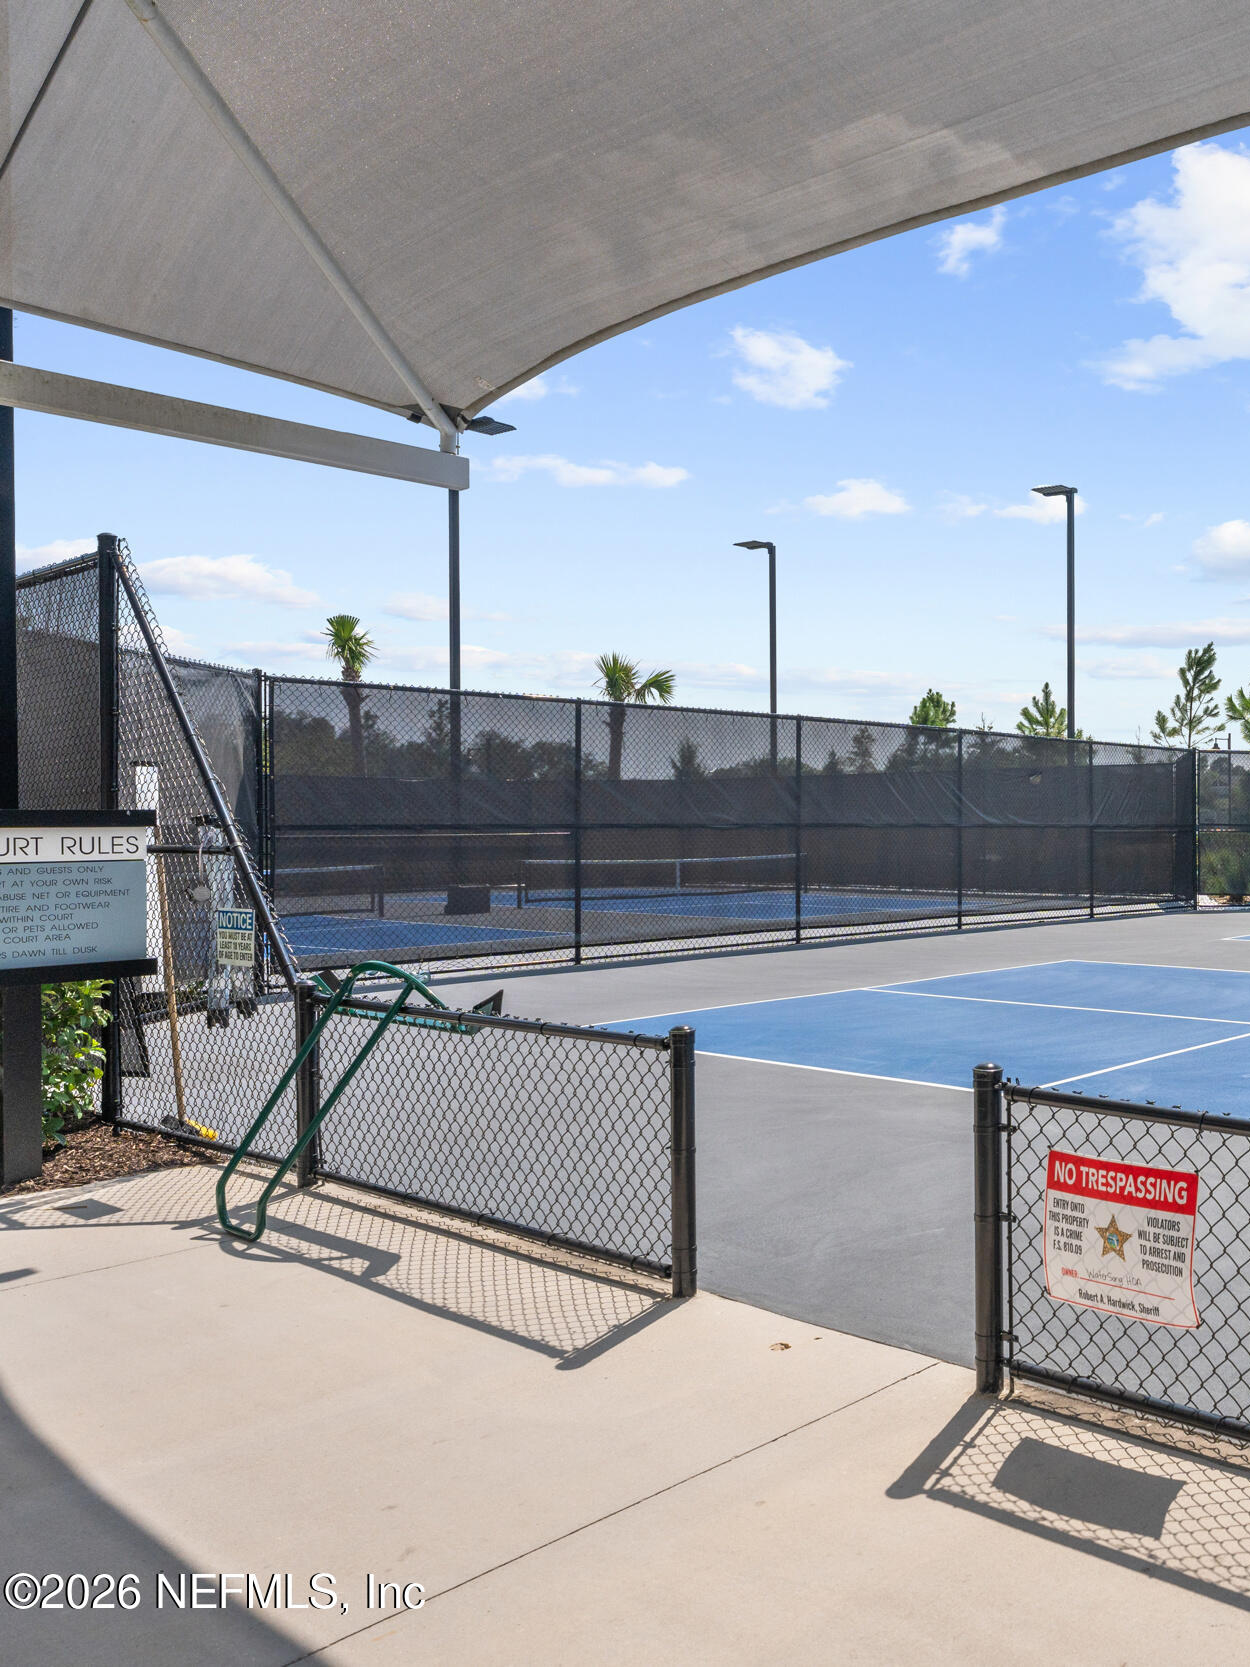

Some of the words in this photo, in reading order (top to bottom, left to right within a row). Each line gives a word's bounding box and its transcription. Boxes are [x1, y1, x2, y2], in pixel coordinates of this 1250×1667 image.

[61, 836, 139, 855] RULES
[7, 867, 31, 876] AND
[37, 866, 73, 875] GUESTS
[77, 865, 105, 873] ONLY
[11, 881, 24, 889] AT
[30, 879, 58, 888] YOUR
[63, 878, 89, 886] OWN
[94, 877, 113, 885] RISK
[32, 892, 50, 900] NET
[56, 891, 70, 899] OR
[76, 889, 131, 898] EQUIPMENT
[26, 903, 49, 912] AND
[55, 901, 111, 911] FOOTWEAR
[0, 915, 34, 923] WITHIN
[40, 913, 74, 922] COURT
[220, 912, 252, 929] NOTICE
[2, 926, 18, 935] OR
[23, 924, 45, 933] PETS
[50, 922, 99, 931] ALLOWED
[219, 931, 227, 940] YOU
[228, 931, 240, 940] MUST
[241, 932, 246, 941] BE
[247, 932, 252, 941] AT
[3, 936, 38, 945] COURT
[44, 934, 72, 942] AREA
[219, 941, 232, 949] LEAST
[238, 942, 251, 951] YEARS
[12, 949, 46, 959] DAWN
[52, 947, 67, 956] TILL
[73, 945, 98, 954] DUSK
[219, 950, 224, 959] OF
[225, 951, 233, 960] AGE
[234, 951, 239, 961] TO
[240, 952, 252, 962] ENTER
[1054, 1160, 1077, 1185] NO
[1080, 1166, 1187, 1205] TRESPASSING
[1053, 1197, 1069, 1211] ENTRY
[1070, 1201, 1085, 1214] ONTO
[1048, 1210, 1061, 1223] THIS
[1061, 1213, 1089, 1229] PROPERTY
[1146, 1215, 1181, 1233] VIOLATORS
[1054, 1226, 1060, 1237] IS
[1060, 1227, 1065, 1238] A
[1065, 1228, 1083, 1242] CRIME
[1137, 1229, 1151, 1243] WILL
[1153, 1232, 1161, 1244] BE
[1162, 1233, 1189, 1249] SUBJECT
[1063, 1241, 1083, 1256] 810.09
[1140, 1243, 1147, 1256] TO
[1148, 1246, 1171, 1261] ARREST
[1172, 1251, 1186, 1264] AND
[1142, 1258, 1183, 1278] PROSECUTION
[1078, 1288, 1098, 1303] Robert
[1100, 1295, 1106, 1305] A.
[1107, 1296, 1138, 1313] Hardwick,
[1138, 1303, 1160, 1317] Sheriff
